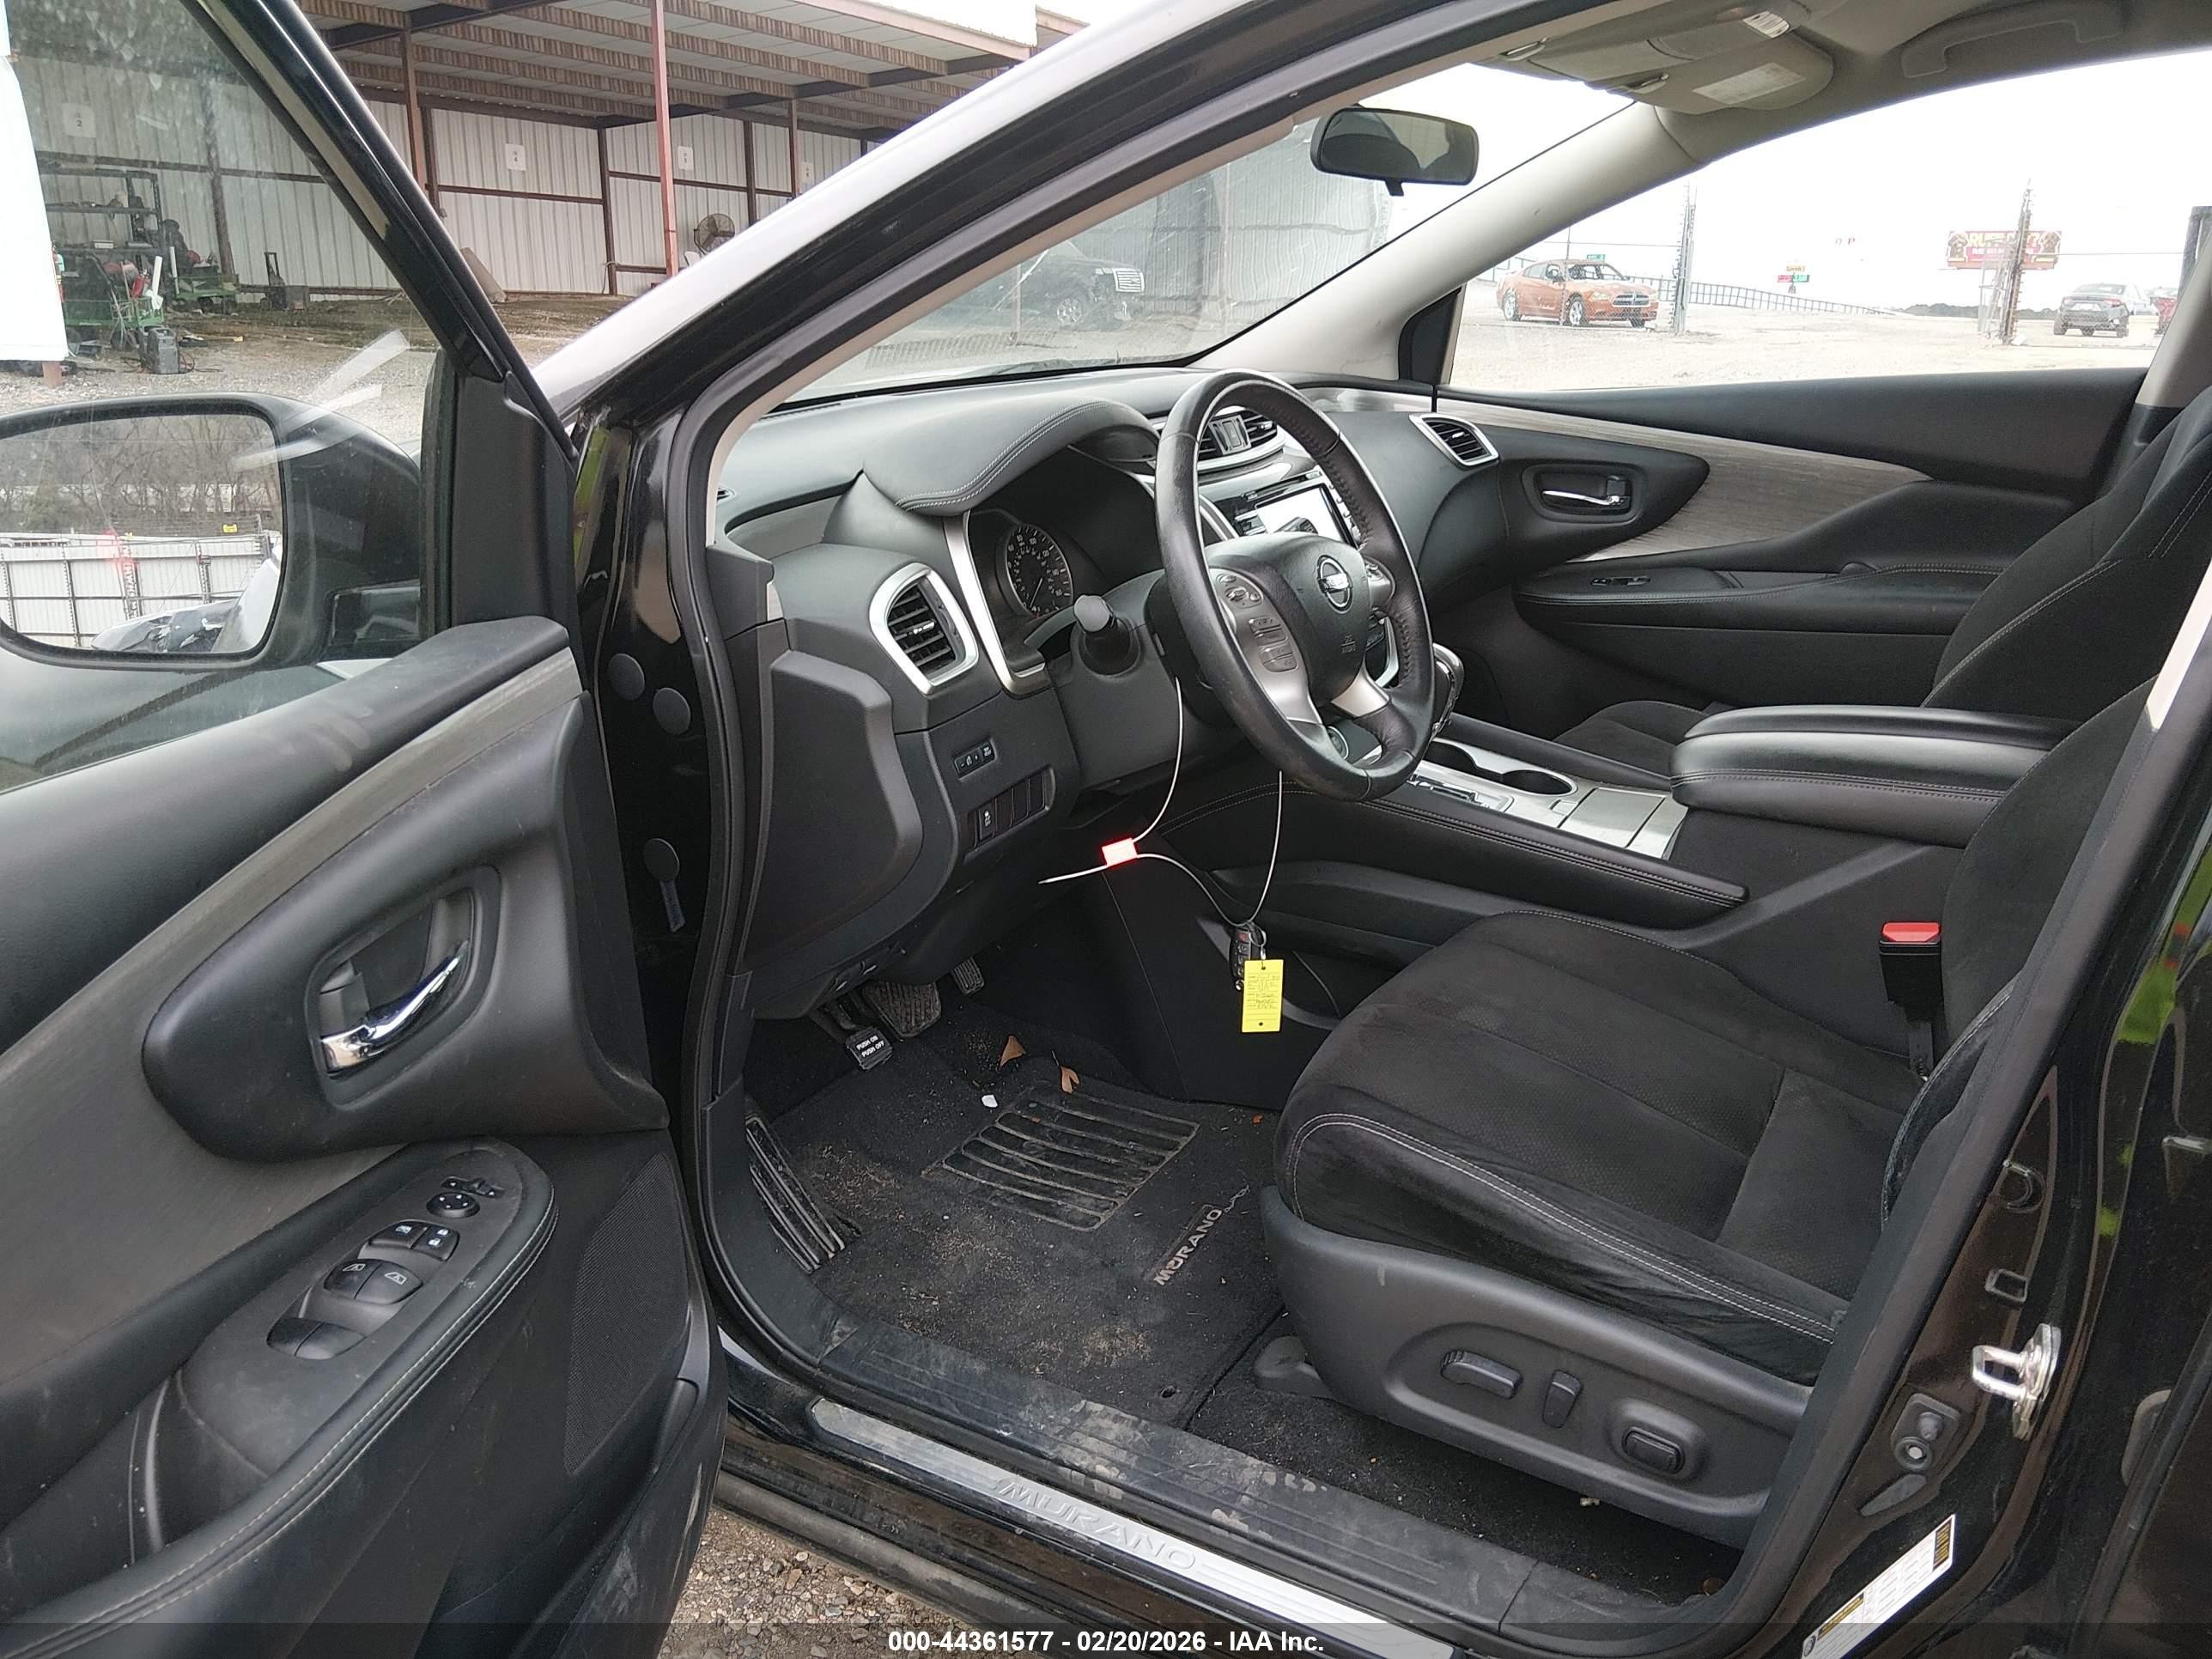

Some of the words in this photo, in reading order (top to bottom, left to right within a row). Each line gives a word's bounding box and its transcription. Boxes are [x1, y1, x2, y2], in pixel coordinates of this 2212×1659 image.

[856, 1039, 872, 1051] PUSH
[861, 1046, 876, 1058] PUSH
[875, 1040, 884, 1049] OFF
[1153, 1209, 1223, 1286] MURANO
[999, 1478, 1196, 1571] MURANO
